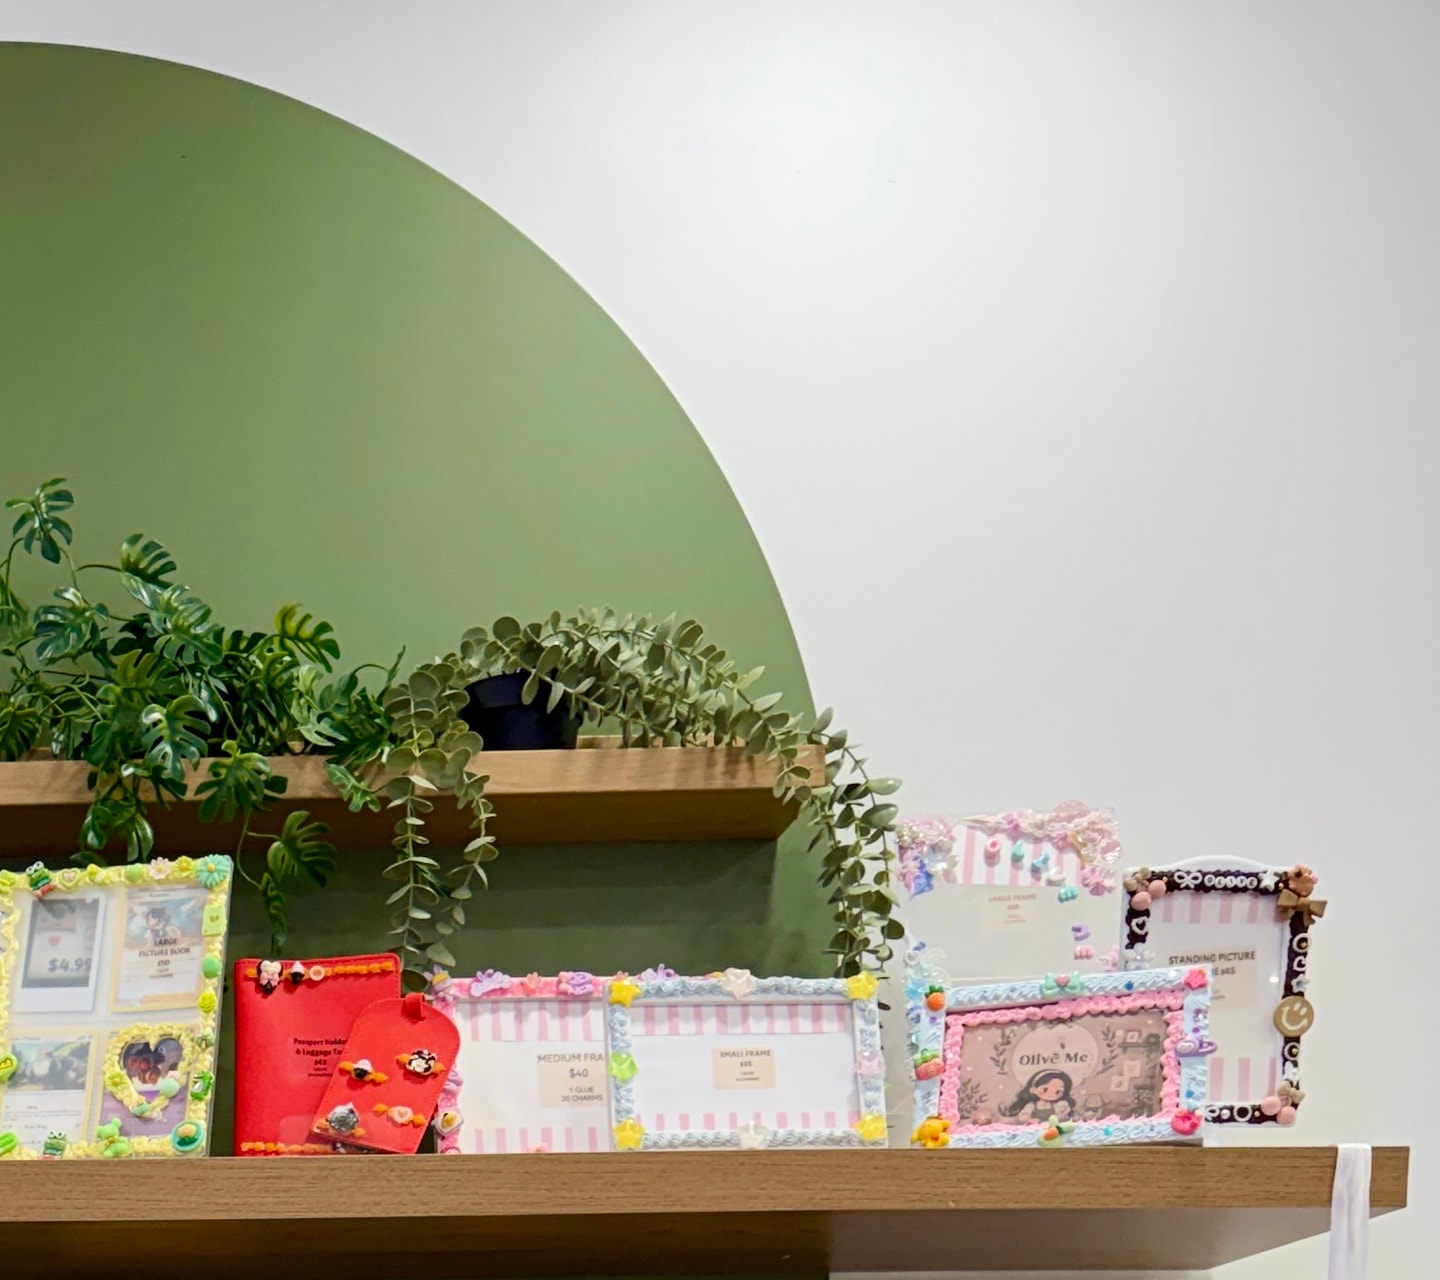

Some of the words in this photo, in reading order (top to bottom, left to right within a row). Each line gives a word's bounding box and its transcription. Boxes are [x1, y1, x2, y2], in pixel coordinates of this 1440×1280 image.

[1169, 954, 1216, 964] STANDING
[1218, 951, 1256, 962] PICTURE
[538, 1054, 581, 1063] MEDIUM
[1019, 1051, 1060, 1065] Olive
[1065, 1052, 1088, 1063] Me
[568, 1068, 589, 1078] $40
